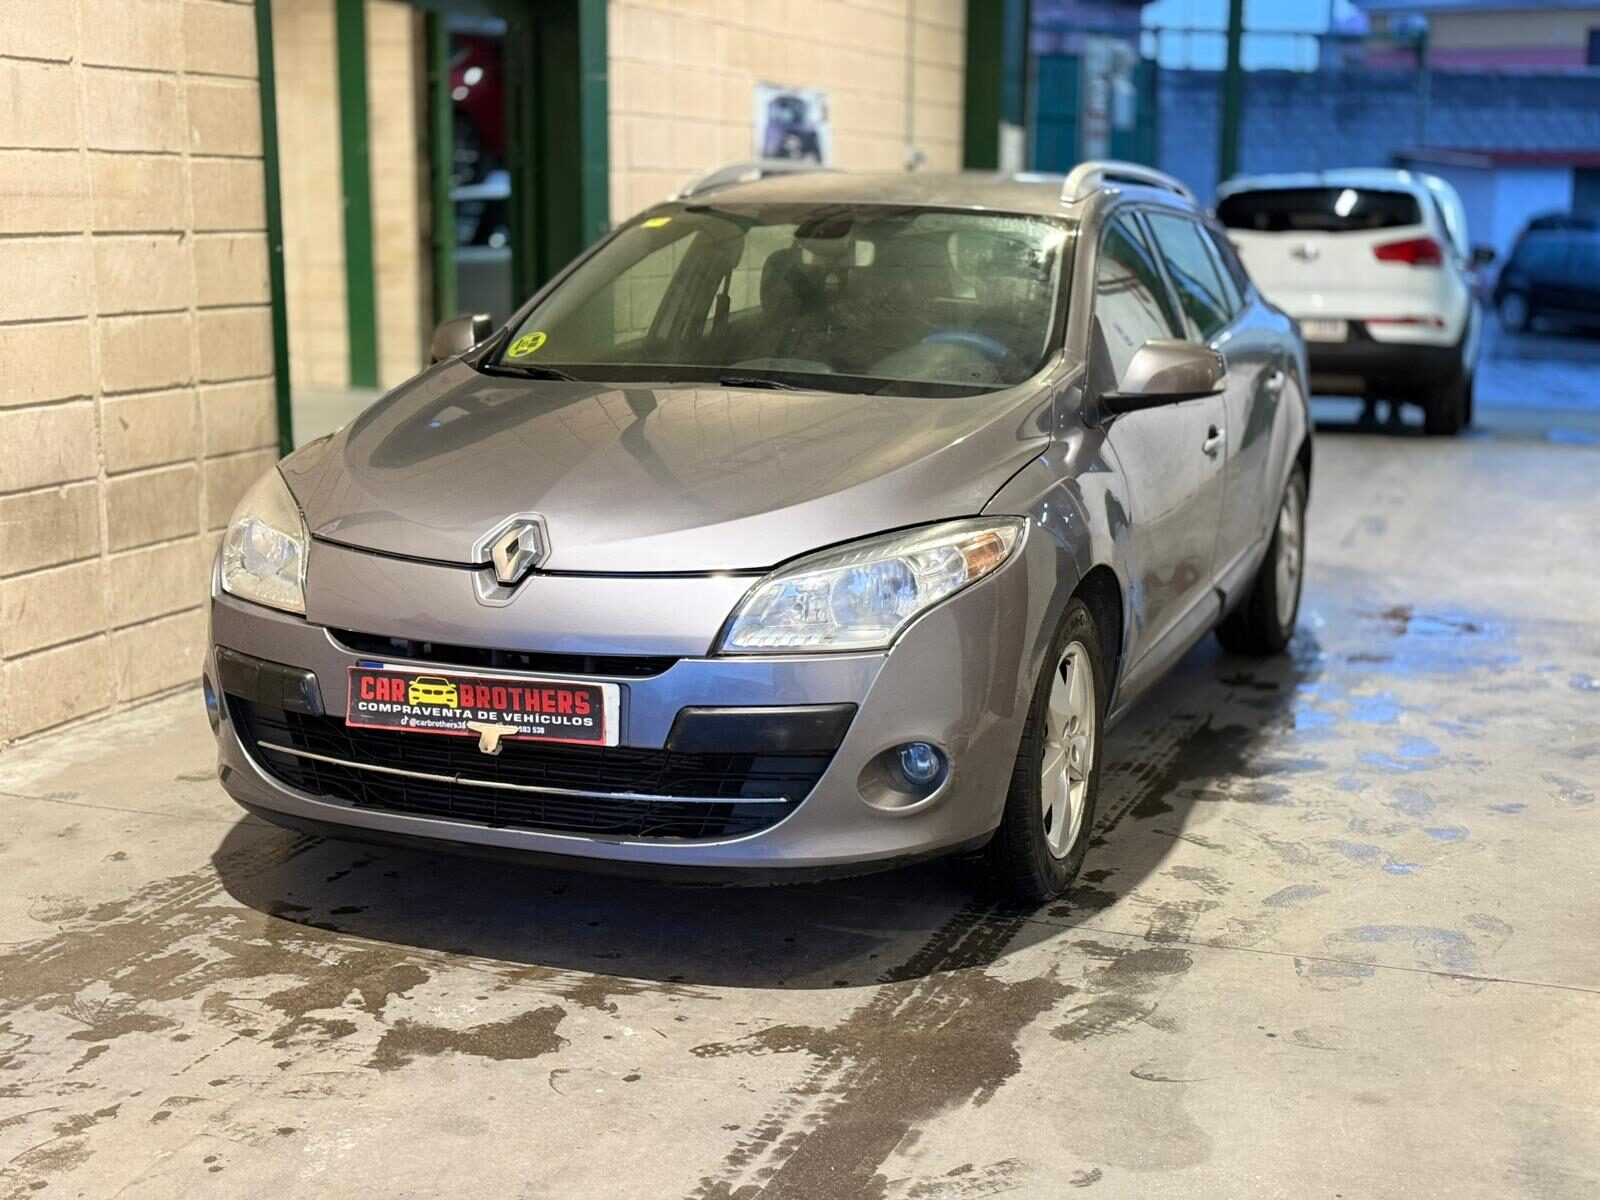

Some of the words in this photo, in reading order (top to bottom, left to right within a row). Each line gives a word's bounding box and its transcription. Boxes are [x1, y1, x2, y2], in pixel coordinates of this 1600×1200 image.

[360, 676, 405, 702] CAR
[460, 684, 591, 714] BROTHERS
[358, 702, 473, 718] COMPRAVENTA
[478, 711, 497, 720] DE
[502, 713, 594, 727] VEHÍCULOS
